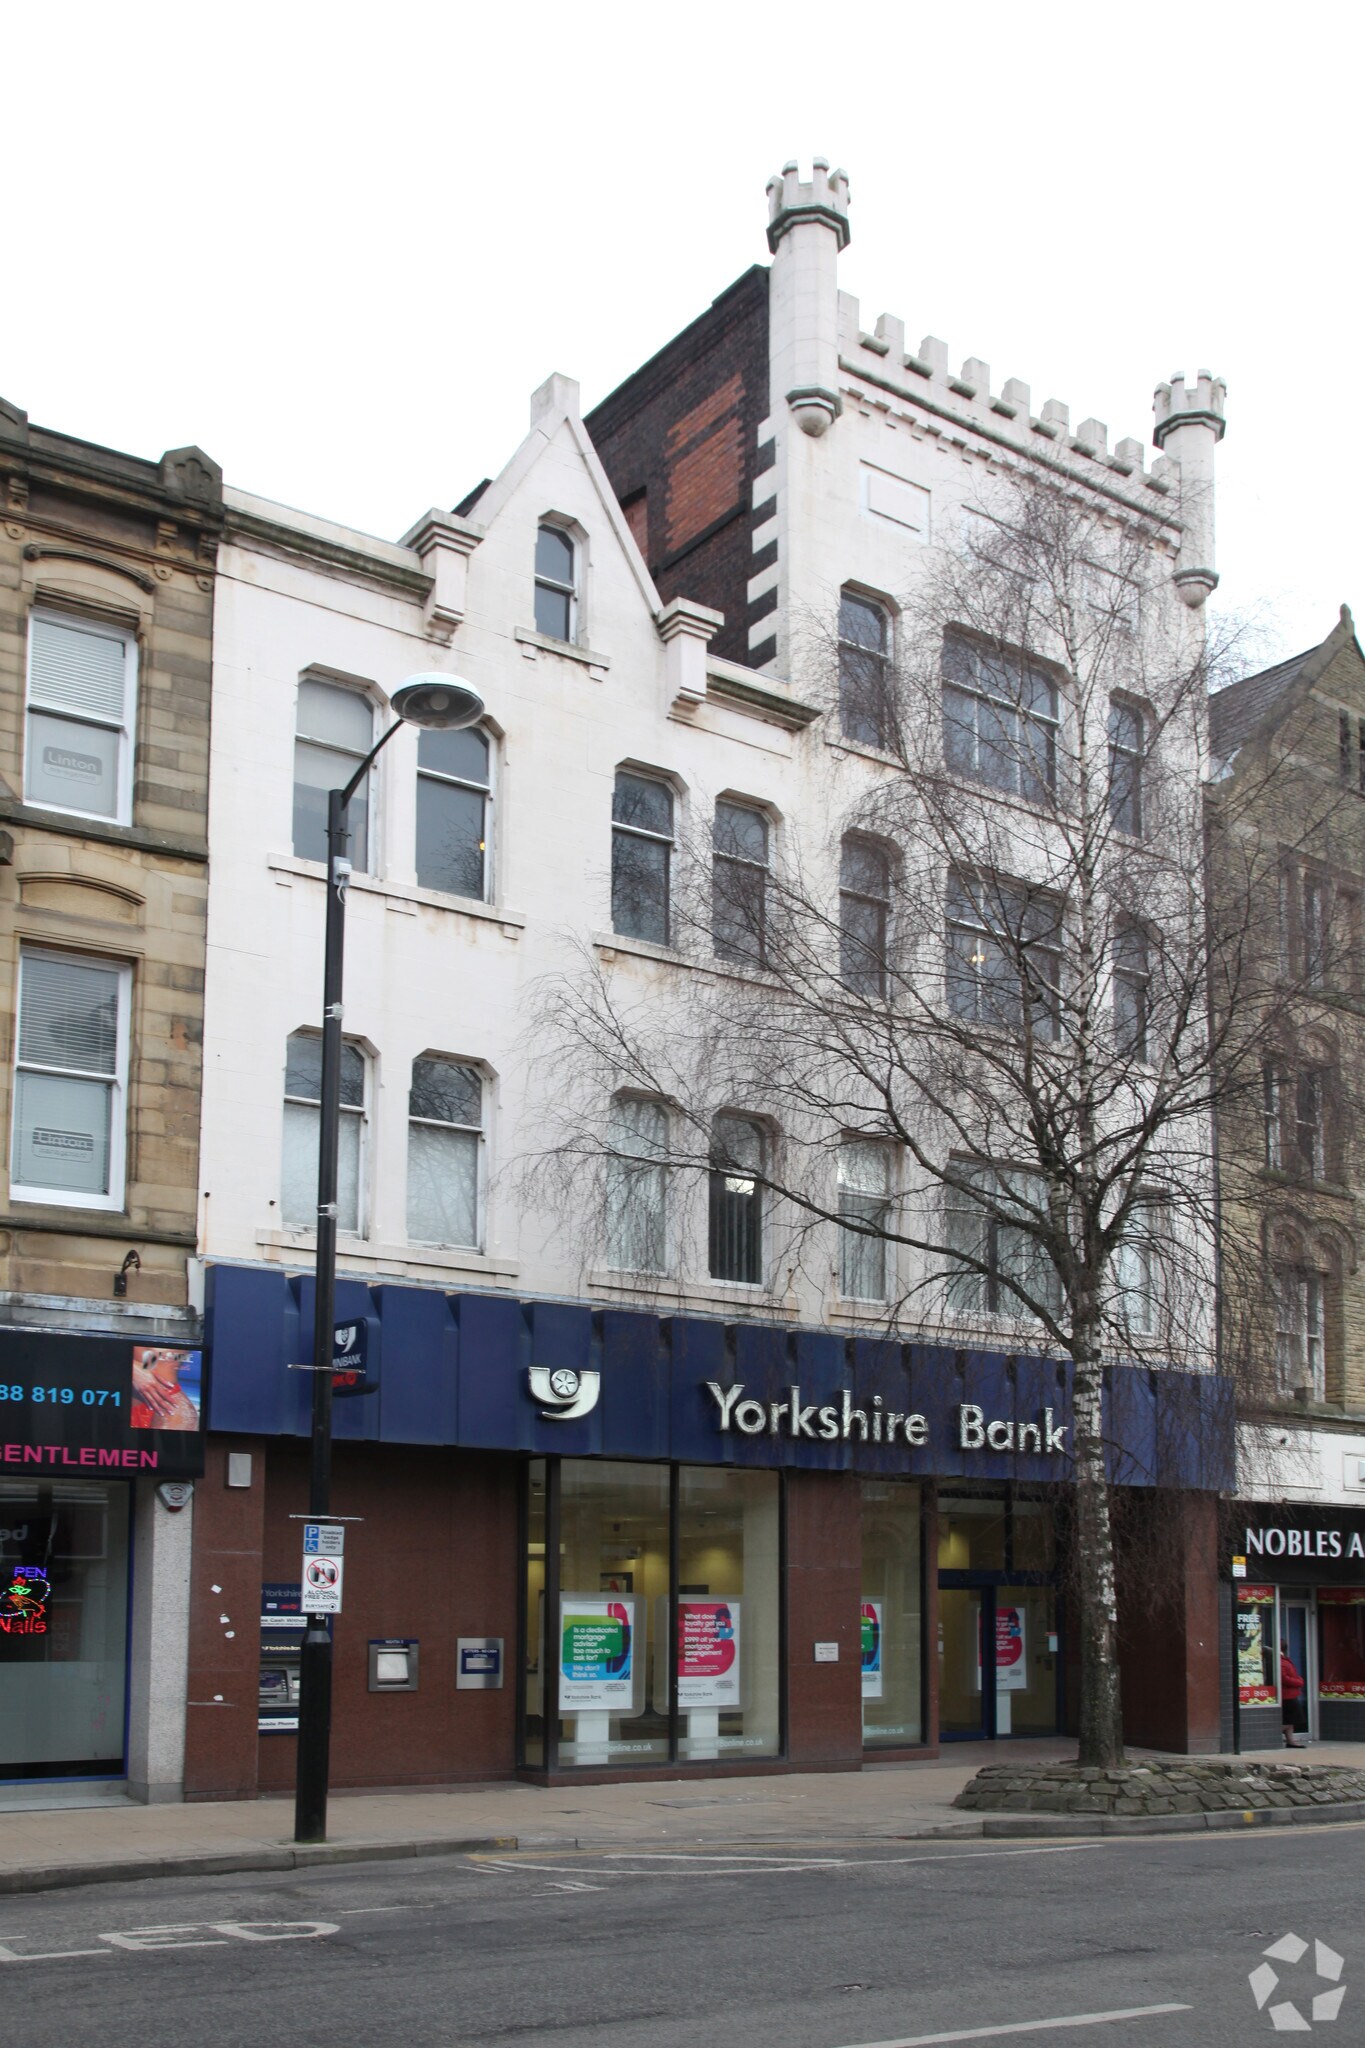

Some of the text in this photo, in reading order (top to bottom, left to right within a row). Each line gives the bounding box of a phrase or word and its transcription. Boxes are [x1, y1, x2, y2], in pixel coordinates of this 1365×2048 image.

[48, 751, 97, 772] Linton
[38, 1131, 88, 1148] Linton
[32, 1386, 74, 1404] 819
[82, 1389, 121, 1407] 071
[706, 1382, 1069, 1453] Yorkshire Bank
[0, 1444, 158, 1468] ENTLEMEN
[1246, 1528, 1342, 1557] NOBLES
[0, 1616, 47, 1634] Nails
[1237, 1614, 1261, 1623] FREE
[1321, 1684, 1345, 1692] SLOTS
